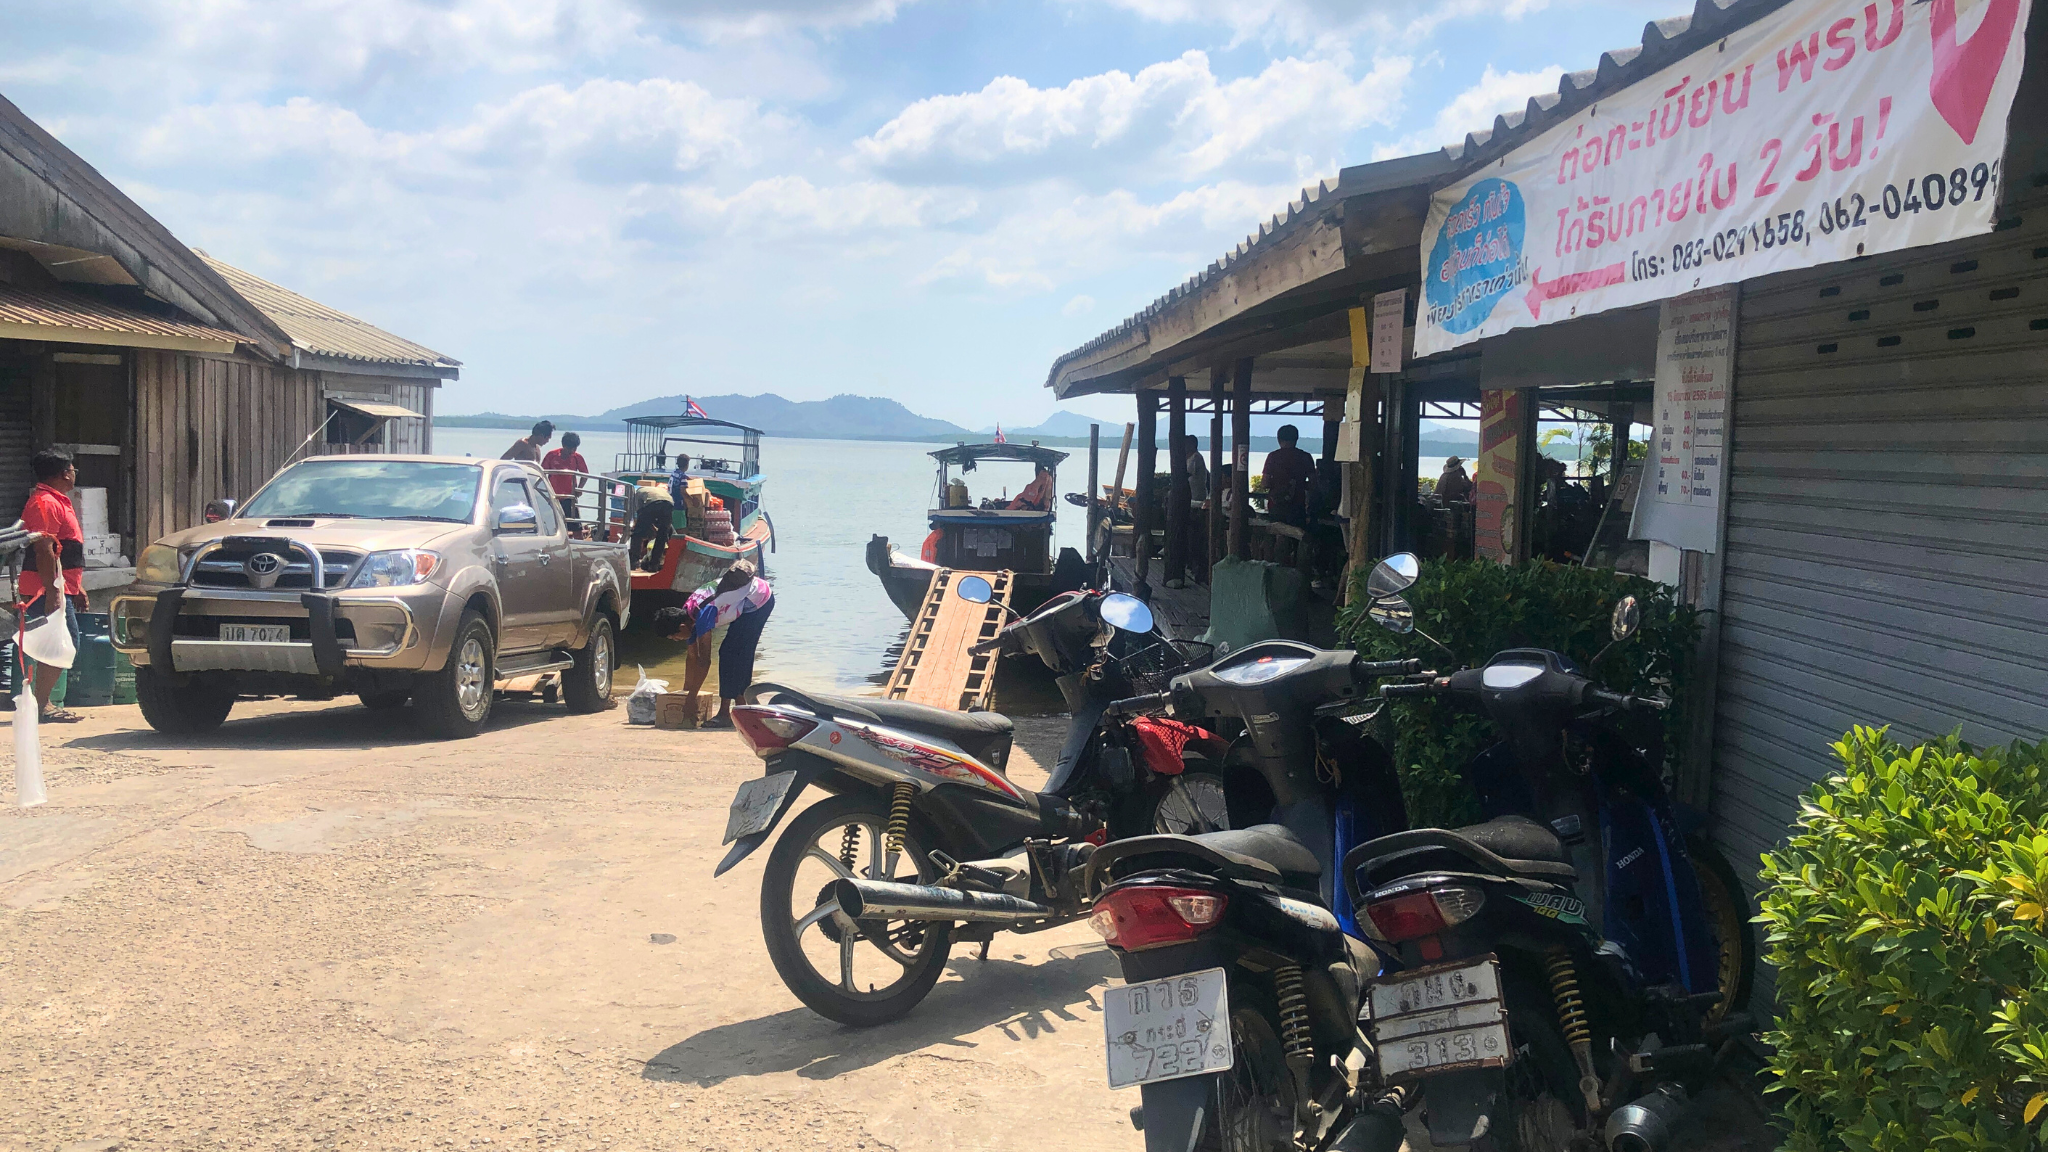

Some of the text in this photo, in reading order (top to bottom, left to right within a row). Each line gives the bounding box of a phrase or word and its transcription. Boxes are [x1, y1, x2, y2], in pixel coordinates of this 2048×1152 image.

[1557, 64, 1754, 184] ต่อทะเบียน
[1556, 95, 1892, 257] ได้รับภายใน 2 วัน!
[1632, 250, 1665, 282] โทร:
[1673, 209, 1810, 271] 083-0291658,
[1614, 846, 1645, 870] HONDA
[1374, 884, 1409, 898] HONDA
[1525, 892, 1586, 917] WAV
[1408, 1033, 1478, 1068] 313
